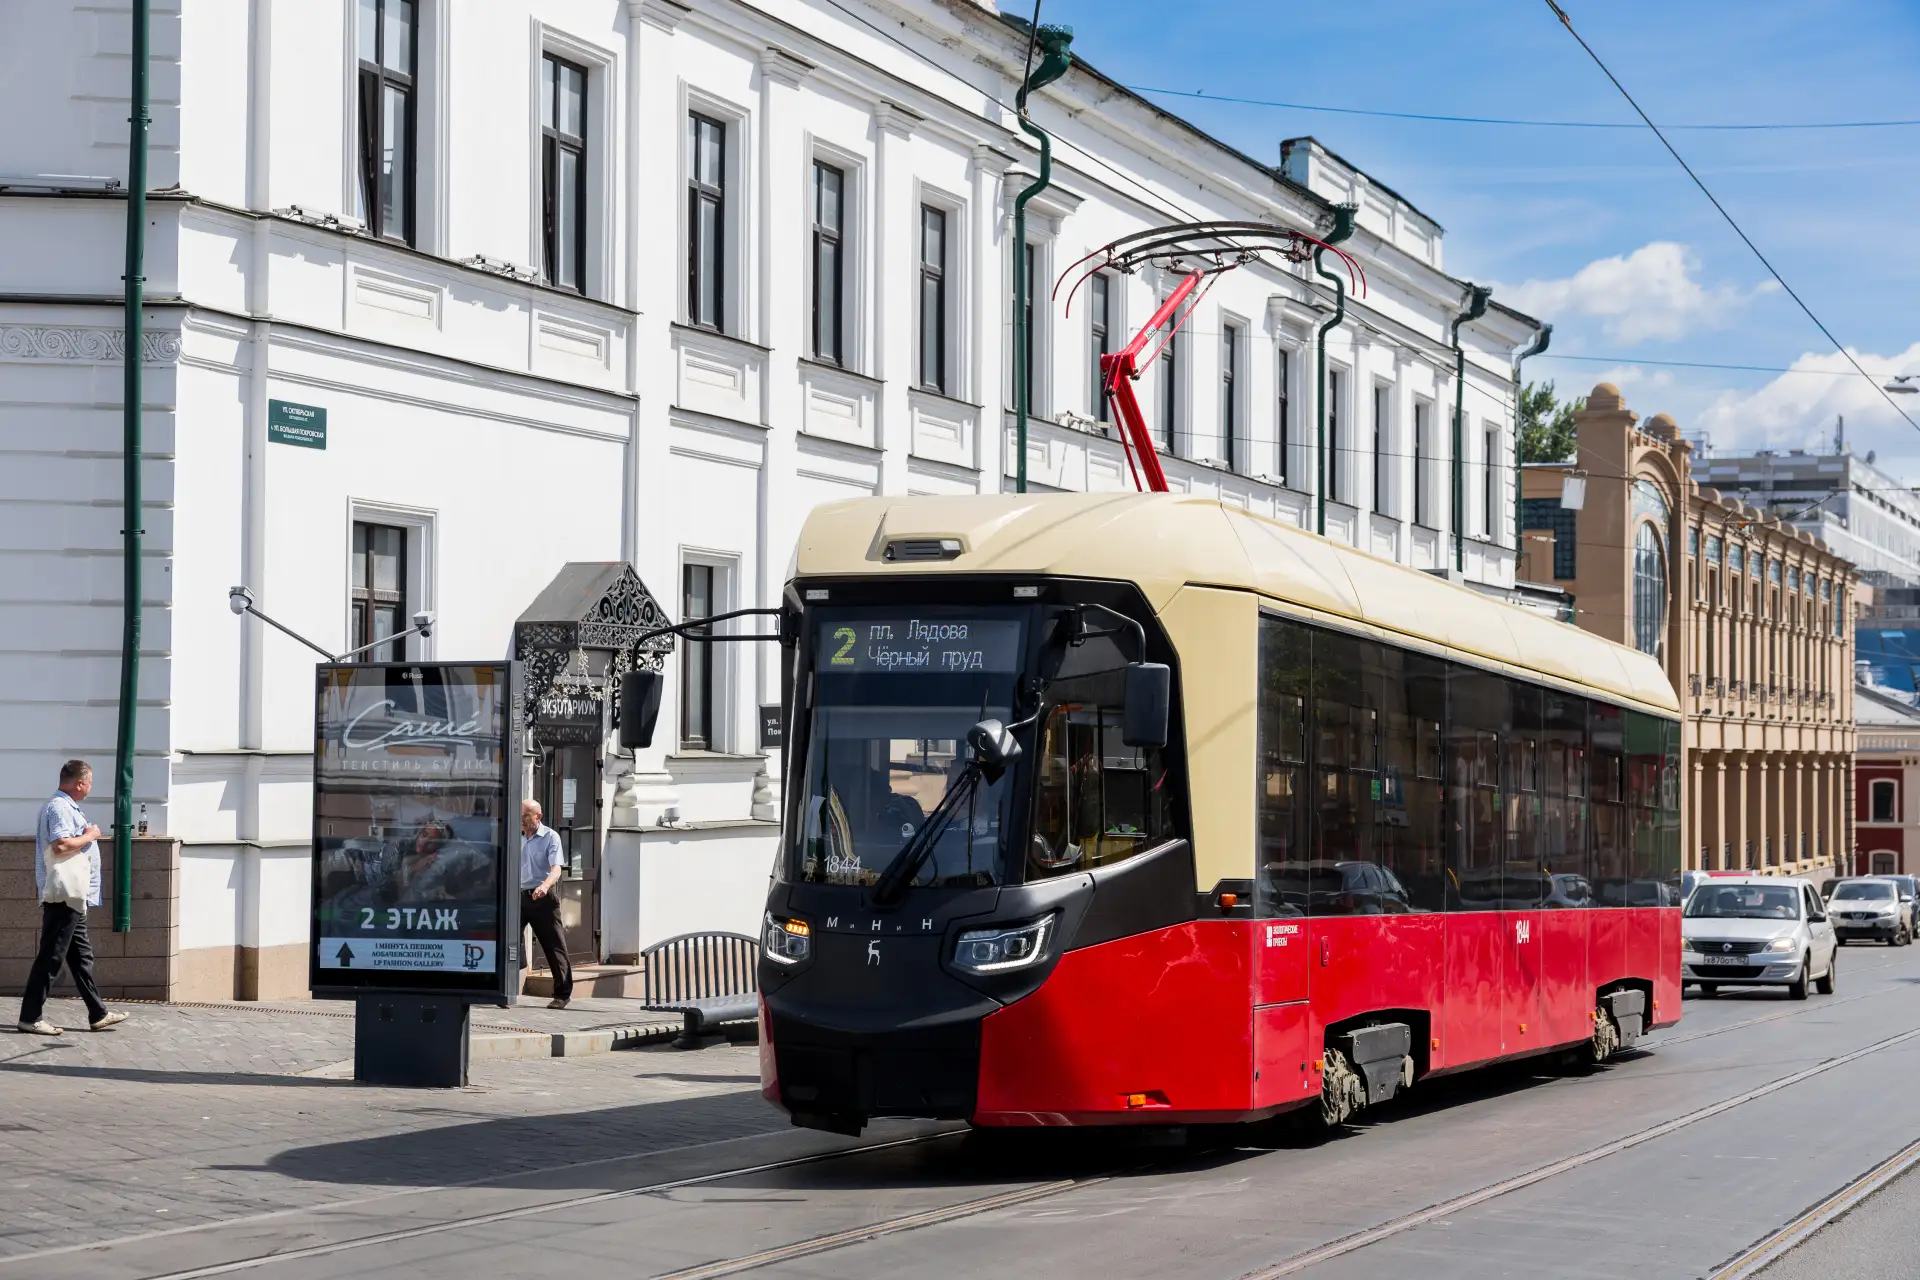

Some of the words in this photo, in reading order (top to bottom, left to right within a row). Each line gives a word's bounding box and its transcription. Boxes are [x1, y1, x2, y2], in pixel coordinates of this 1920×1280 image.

[869, 625, 894, 640] пл.
[906, 619, 968, 642] Лядова
[831, 627, 857, 665] 2
[867, 645, 930, 671] Чёрный
[941, 651, 983, 671] пруд
[541, 699, 596, 715] ЭКЗОТАРИУМ
[767, 718, 779, 726] ул.
[342, 760, 421, 771] ТЕКСТИЛЬ
[432, 760, 484, 771] БУТИК
[824, 855, 861, 873] 1844
[361, 908, 375, 929] 2
[386, 908, 459, 930] ЭТАЖ
[1516, 920, 1530, 944] 1844
